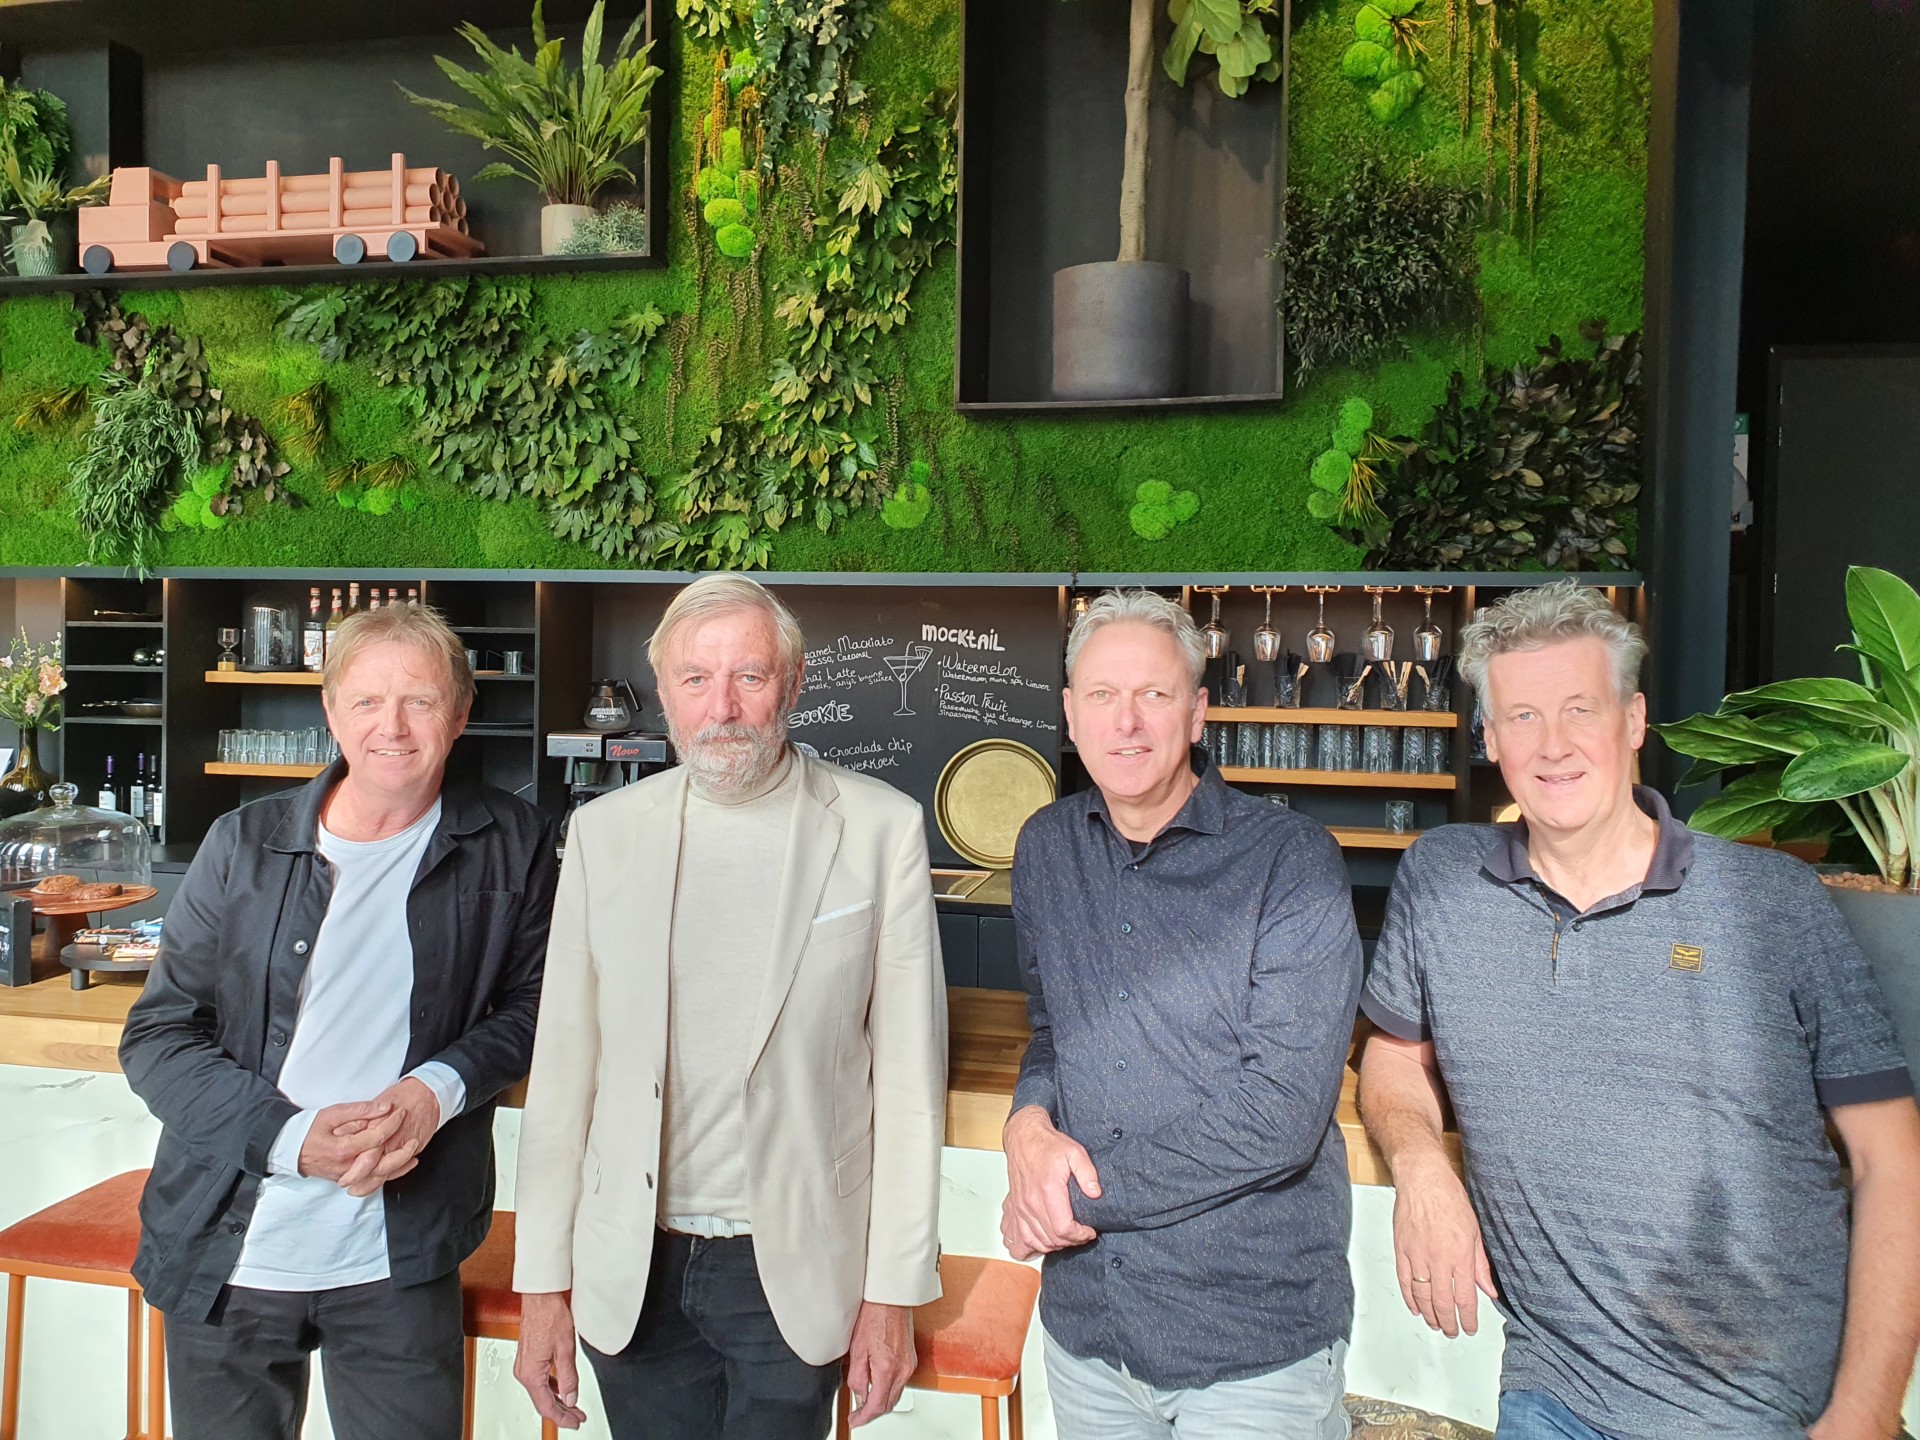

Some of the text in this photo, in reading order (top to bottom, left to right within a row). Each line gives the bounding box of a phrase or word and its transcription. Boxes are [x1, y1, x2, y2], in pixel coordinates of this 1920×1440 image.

[942, 651, 1021, 678] Watermelon
[801, 671, 822, 685] hai
[940, 683, 1008, 712] Passion Fruit
[1036, 719, 1057, 731] Limoe
[888, 737, 913, 754] chip
